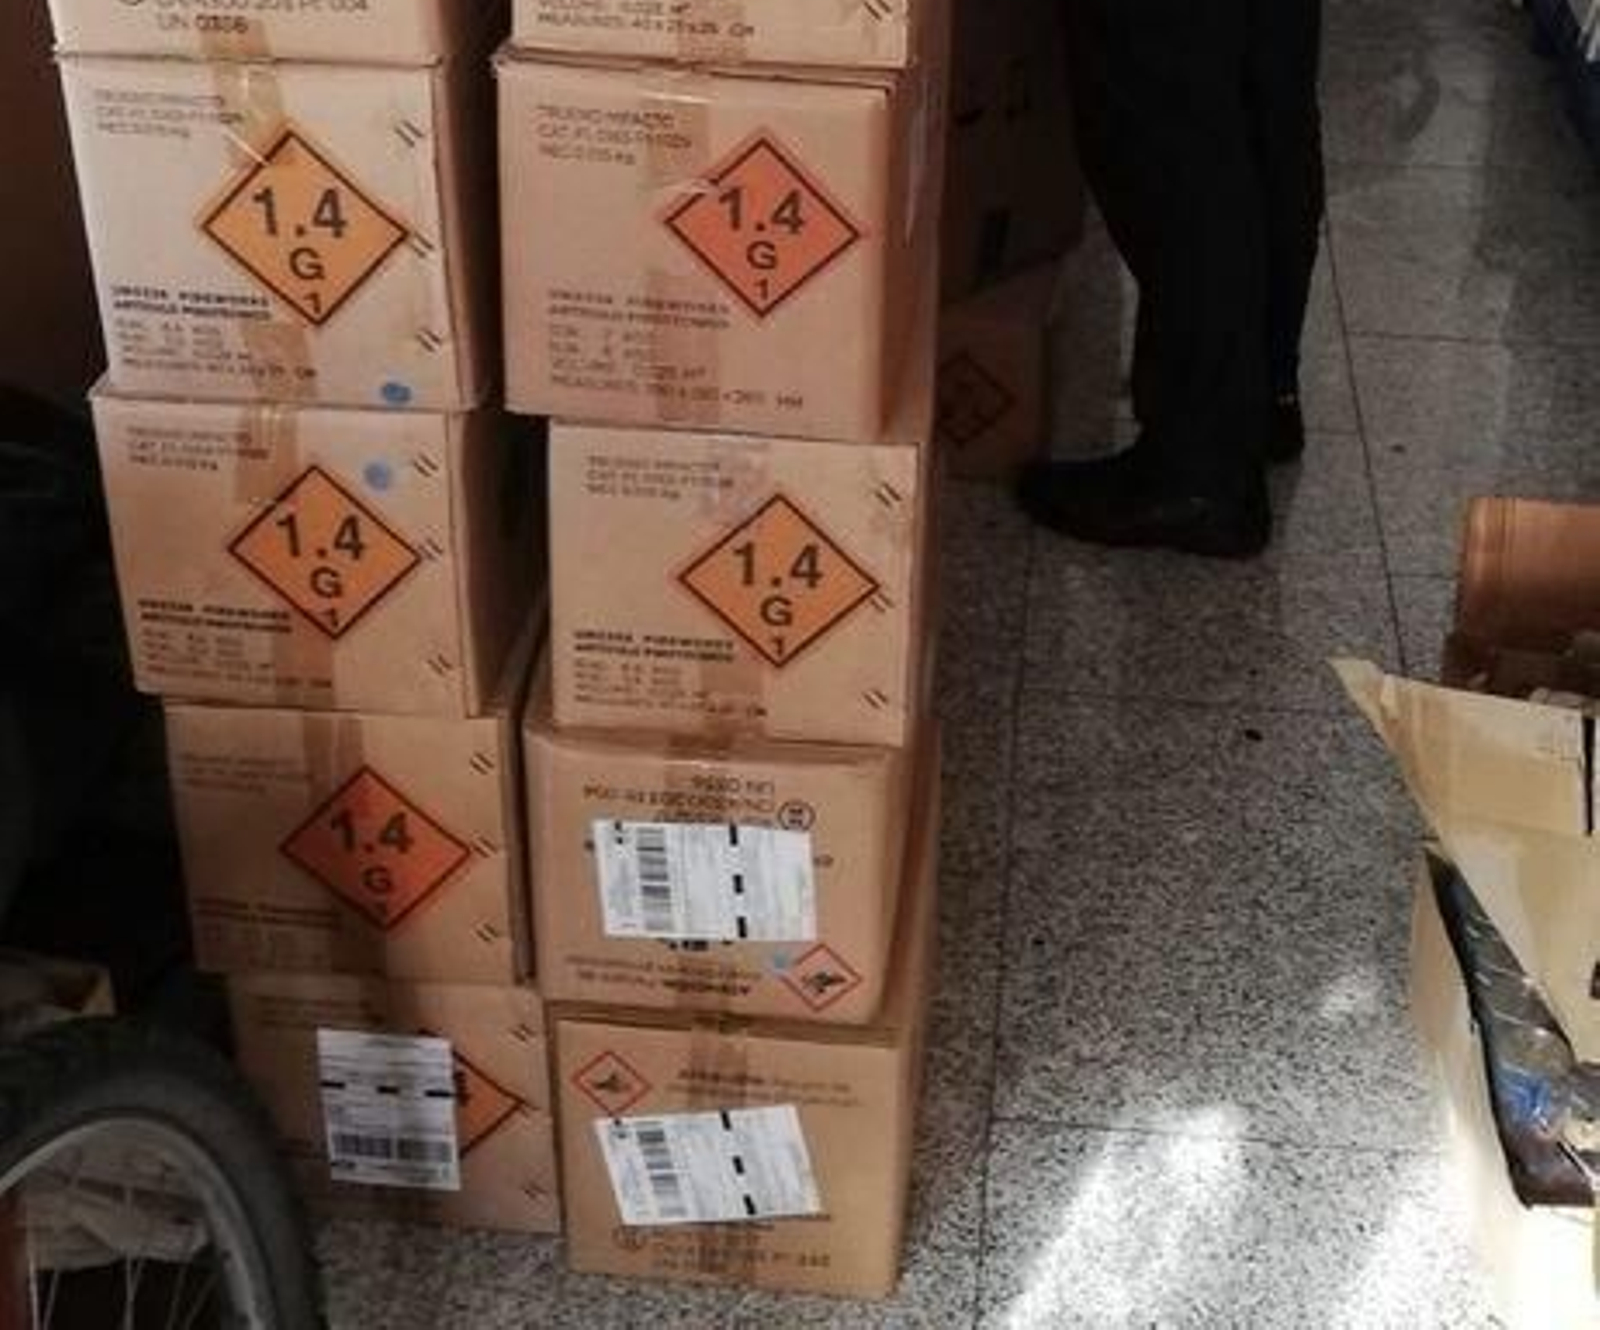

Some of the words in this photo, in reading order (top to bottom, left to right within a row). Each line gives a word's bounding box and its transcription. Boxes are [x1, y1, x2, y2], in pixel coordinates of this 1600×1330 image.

[252, 185, 348, 239] 1.4
[718, 186, 806, 236] 1.4
[288, 247, 327, 281] G
[746, 240, 779, 271] G
[302, 292, 323, 315] 1
[756, 278, 771, 301] 1
[276, 513, 366, 562] 1.4
[732, 540, 824, 590] 1.4
[310, 567, 344, 599] G
[759, 594, 794, 628] G
[770, 636, 786, 657] 1
[331, 808, 414, 856] 1.4
[362, 865, 394, 896] G
